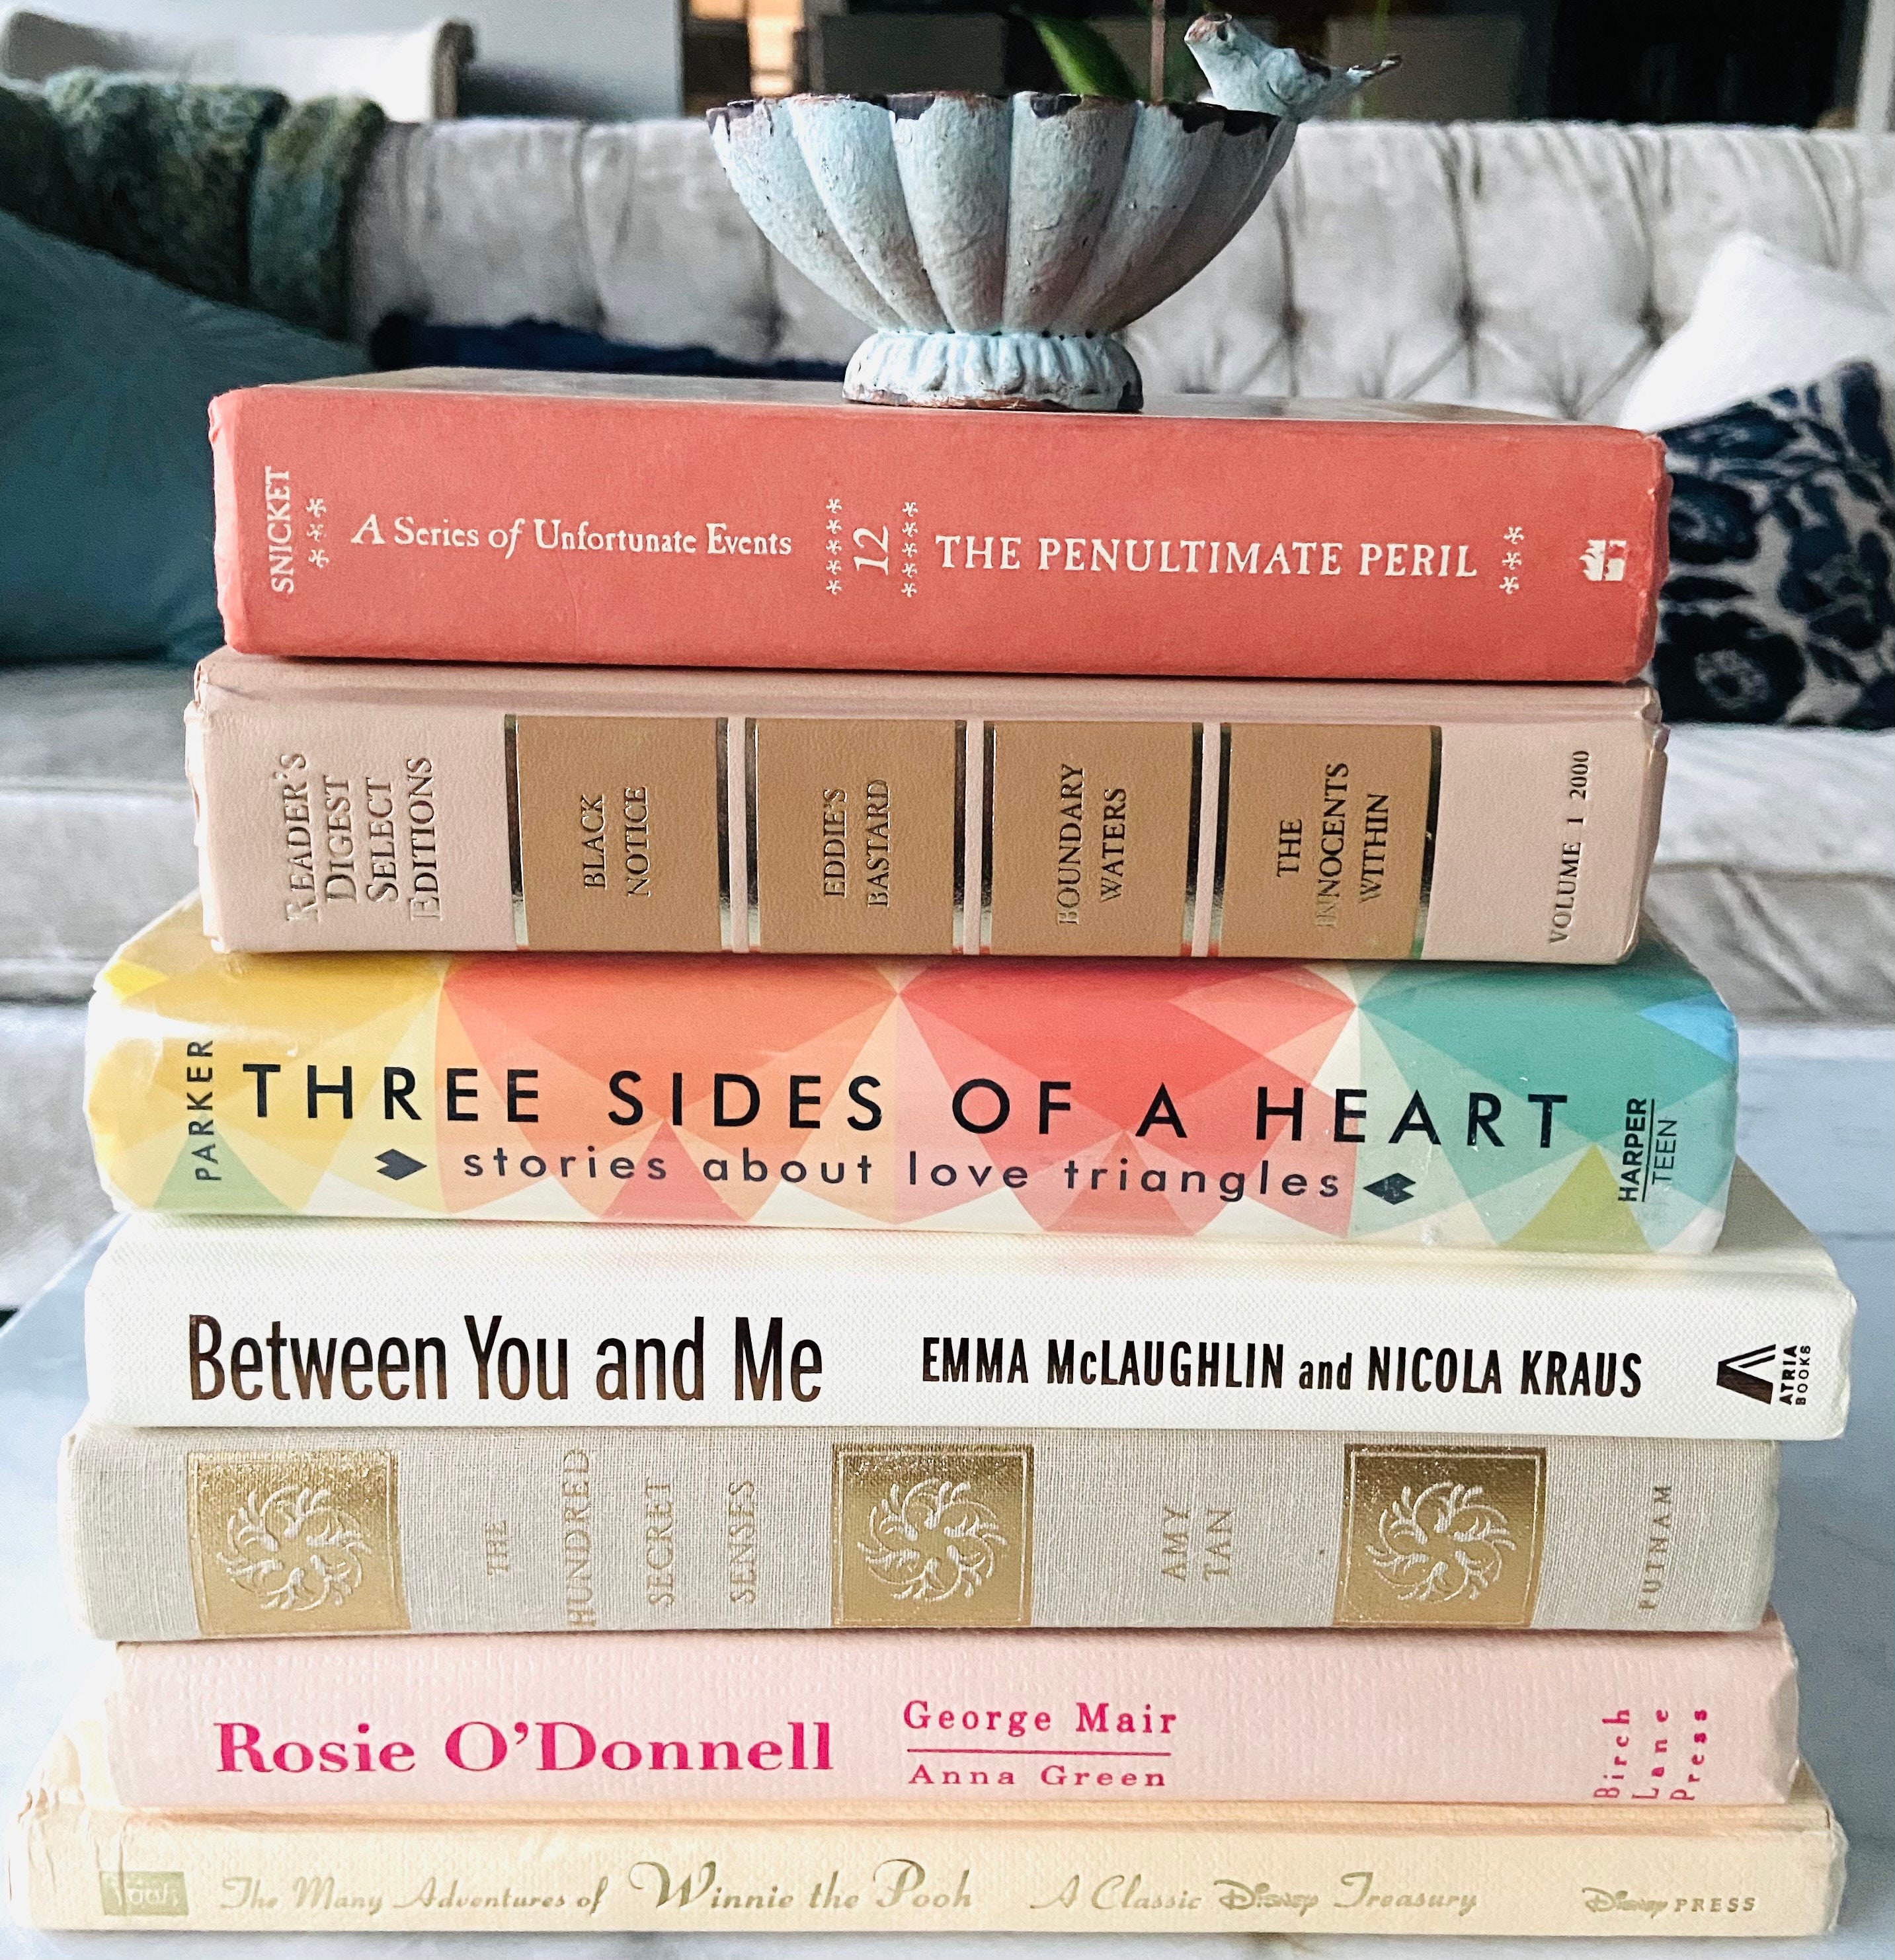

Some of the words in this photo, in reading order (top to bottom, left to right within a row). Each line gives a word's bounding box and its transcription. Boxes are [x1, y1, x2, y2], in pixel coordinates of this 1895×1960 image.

[265, 467, 294, 594] SNICKET
[351, 514, 385, 545] A
[395, 518, 479, 548] Series
[488, 518, 525, 559] of
[535, 520, 696, 554] Unfortunate
[706, 522, 791, 556] Events
[854, 526, 889, 574] 12
[936, 535, 1022, 571] THE
[1038, 536, 1342, 576] PENULTIMATE
[1358, 542, 1477, 578] PERIL
[1569, 750, 1592, 801] 2000
[323, 775, 359, 904] DIGEST
[365, 777, 400, 904] SELECT
[405, 756, 442, 921] EDITIONS
[581, 795, 608, 890] BLACK
[624, 786, 651, 898] NOTICE
[866, 779, 891, 908] BASTARD
[1057, 763, 1085, 925] BOUNDARY
[1100, 788, 1127, 902] WATERS
[1277, 818, 1303, 877] THE
[1316, 762, 1350, 927] INNOCENTS
[1358, 794, 1389, 903] WITHIN
[1568, 816, 1585, 827] 1
[1549, 841, 1583, 945] VOLUME
[186, 1040, 222, 1182] PARKER
[242, 1062, 540, 1124] THREE
[608, 1070, 883, 1131] SIDES
[951, 1078, 1072, 1135] OF
[1135, 1081, 1188, 1139] A
[1255, 1085, 1568, 1148] HEART
[463, 1146, 668, 1181] stories
[702, 1150, 873, 1185] about
[909, 1151, 1029, 1189] love
[1063, 1157, 1340, 1203] triangles
[1618, 1098, 1646, 1202] HARPER
[1652, 1120, 1677, 1185] TEEN
[189, 1313, 447, 1402] Between
[464, 1314, 569, 1402] You
[596, 1315, 706, 1402] and
[735, 1315, 823, 1403] Me
[922, 1337, 1029, 1384] EMMA
[1047, 1339, 1284, 1391] McLAUGHLIN
[1298, 1352, 1351, 1392] and
[1368, 1346, 1502, 1395] NICOLA
[1519, 1350, 1642, 1399] KRAUS
[1779, 1345, 1797, 1405] ATRIA
[1795, 1345, 1811, 1405] BOOKS
[485, 1520, 509, 1577] THE
[562, 1449, 596, 1628] HUNDRED
[645, 1477, 675, 1608] SECRET
[729, 1481, 757, 1605] SENSES
[1160, 1505, 1191, 1582] AMY
[1202, 1509, 1234, 1582] TAN
[1638, 1485, 1673, 1611] PUTNAM
[214, 1721, 415, 1772] Rosie
[903, 1700, 1052, 1738] George
[1075, 1702, 1177, 1733] Mair
[1593, 1709, 1630, 1798] Birch
[1631, 1709, 1668, 1799] Lane
[1670, 1709, 1707, 1801] Press
[908, 1764, 1016, 1785] Anna
[1041, 1765, 1166, 1787] Green
[220, 1876, 278, 1909] The
[292, 1876, 383, 1916] Many
[392, 1877, 566, 1909] Adventures
[576, 1875, 609, 1915] of
[629, 1860, 794, 1910] Winnie
[808, 1870, 859, 1910] the
[872, 1858, 971, 1909] Pooh
[1030, 1875, 1079, 1910] A
[1091, 1875, 1202, 1911] Classic
[1332, 1871, 1477, 1917] Treasury
[1674, 1895, 1756, 1913] PRESS
